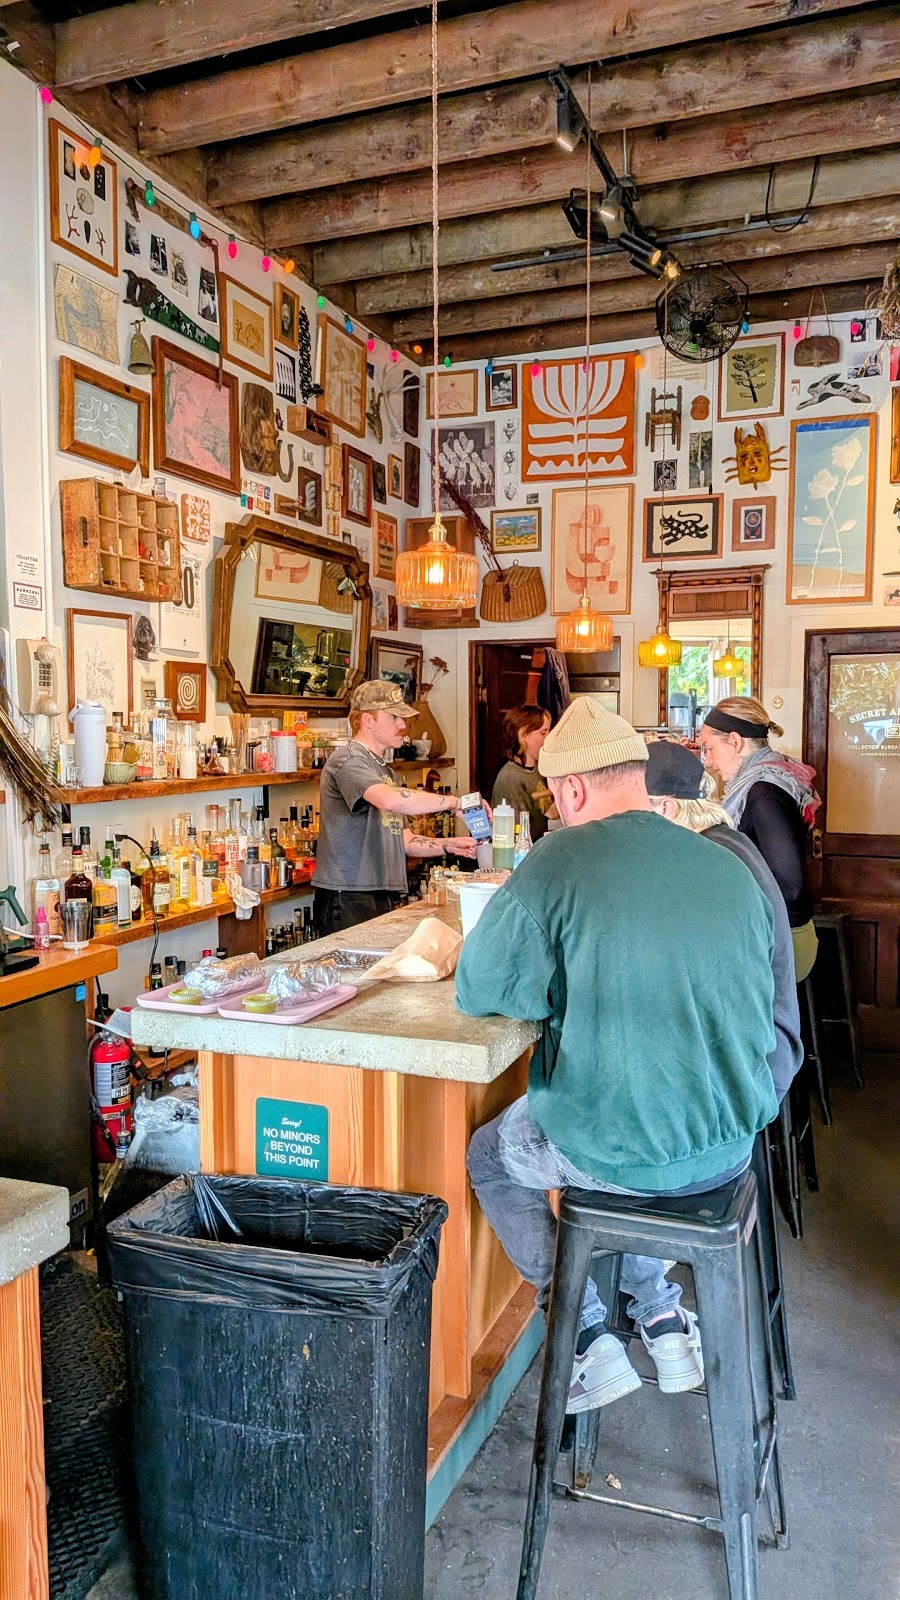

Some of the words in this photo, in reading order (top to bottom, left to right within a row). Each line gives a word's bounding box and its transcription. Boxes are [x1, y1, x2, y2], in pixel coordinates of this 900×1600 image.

[849, 708, 886, 723] SECRET
[281, 1117, 302, 1128] Sorry!
[263, 1127, 278, 1138] NO
[280, 1130, 320, 1144] MINORS
[270, 1140, 312, 1155] BEYOND
[264, 1151, 286, 1164] THIS
[289, 1155, 319, 1169] POINT
[664, 1340, 680, 1349] NIKE
